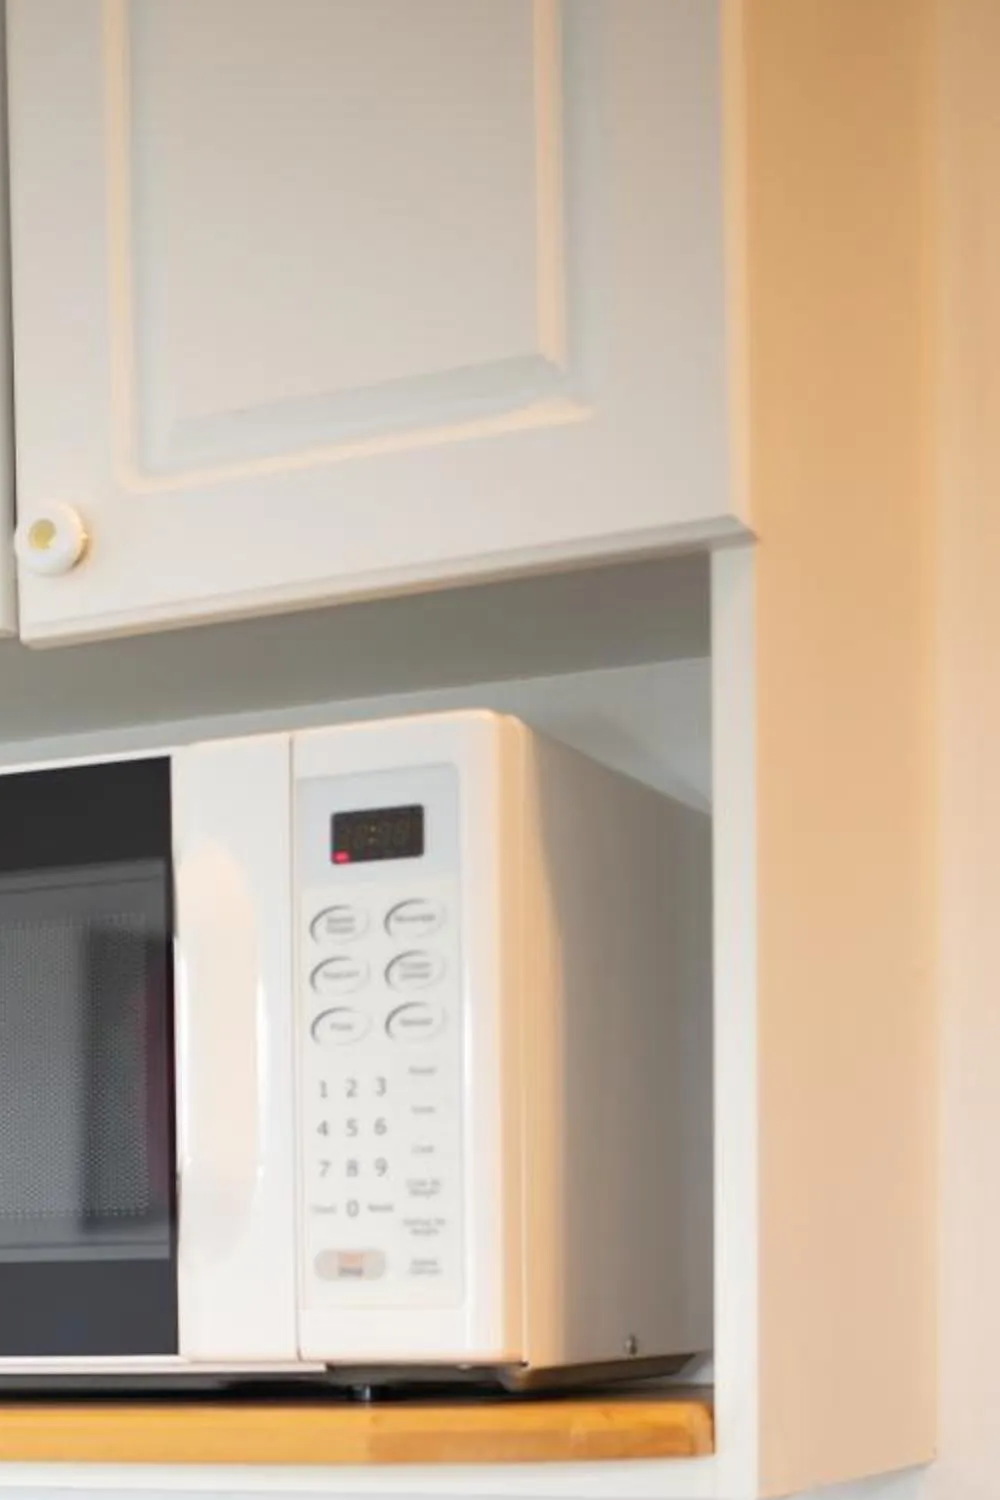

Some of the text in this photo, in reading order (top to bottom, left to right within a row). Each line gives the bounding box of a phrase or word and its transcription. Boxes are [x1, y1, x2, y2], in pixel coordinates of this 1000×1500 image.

[318, 1076, 388, 1099] 1 2 3
[315, 1115, 388, 1138] 4 5 6
[317, 1156, 389, 1178] 7 8 9
[345, 1198, 360, 1218] 0
